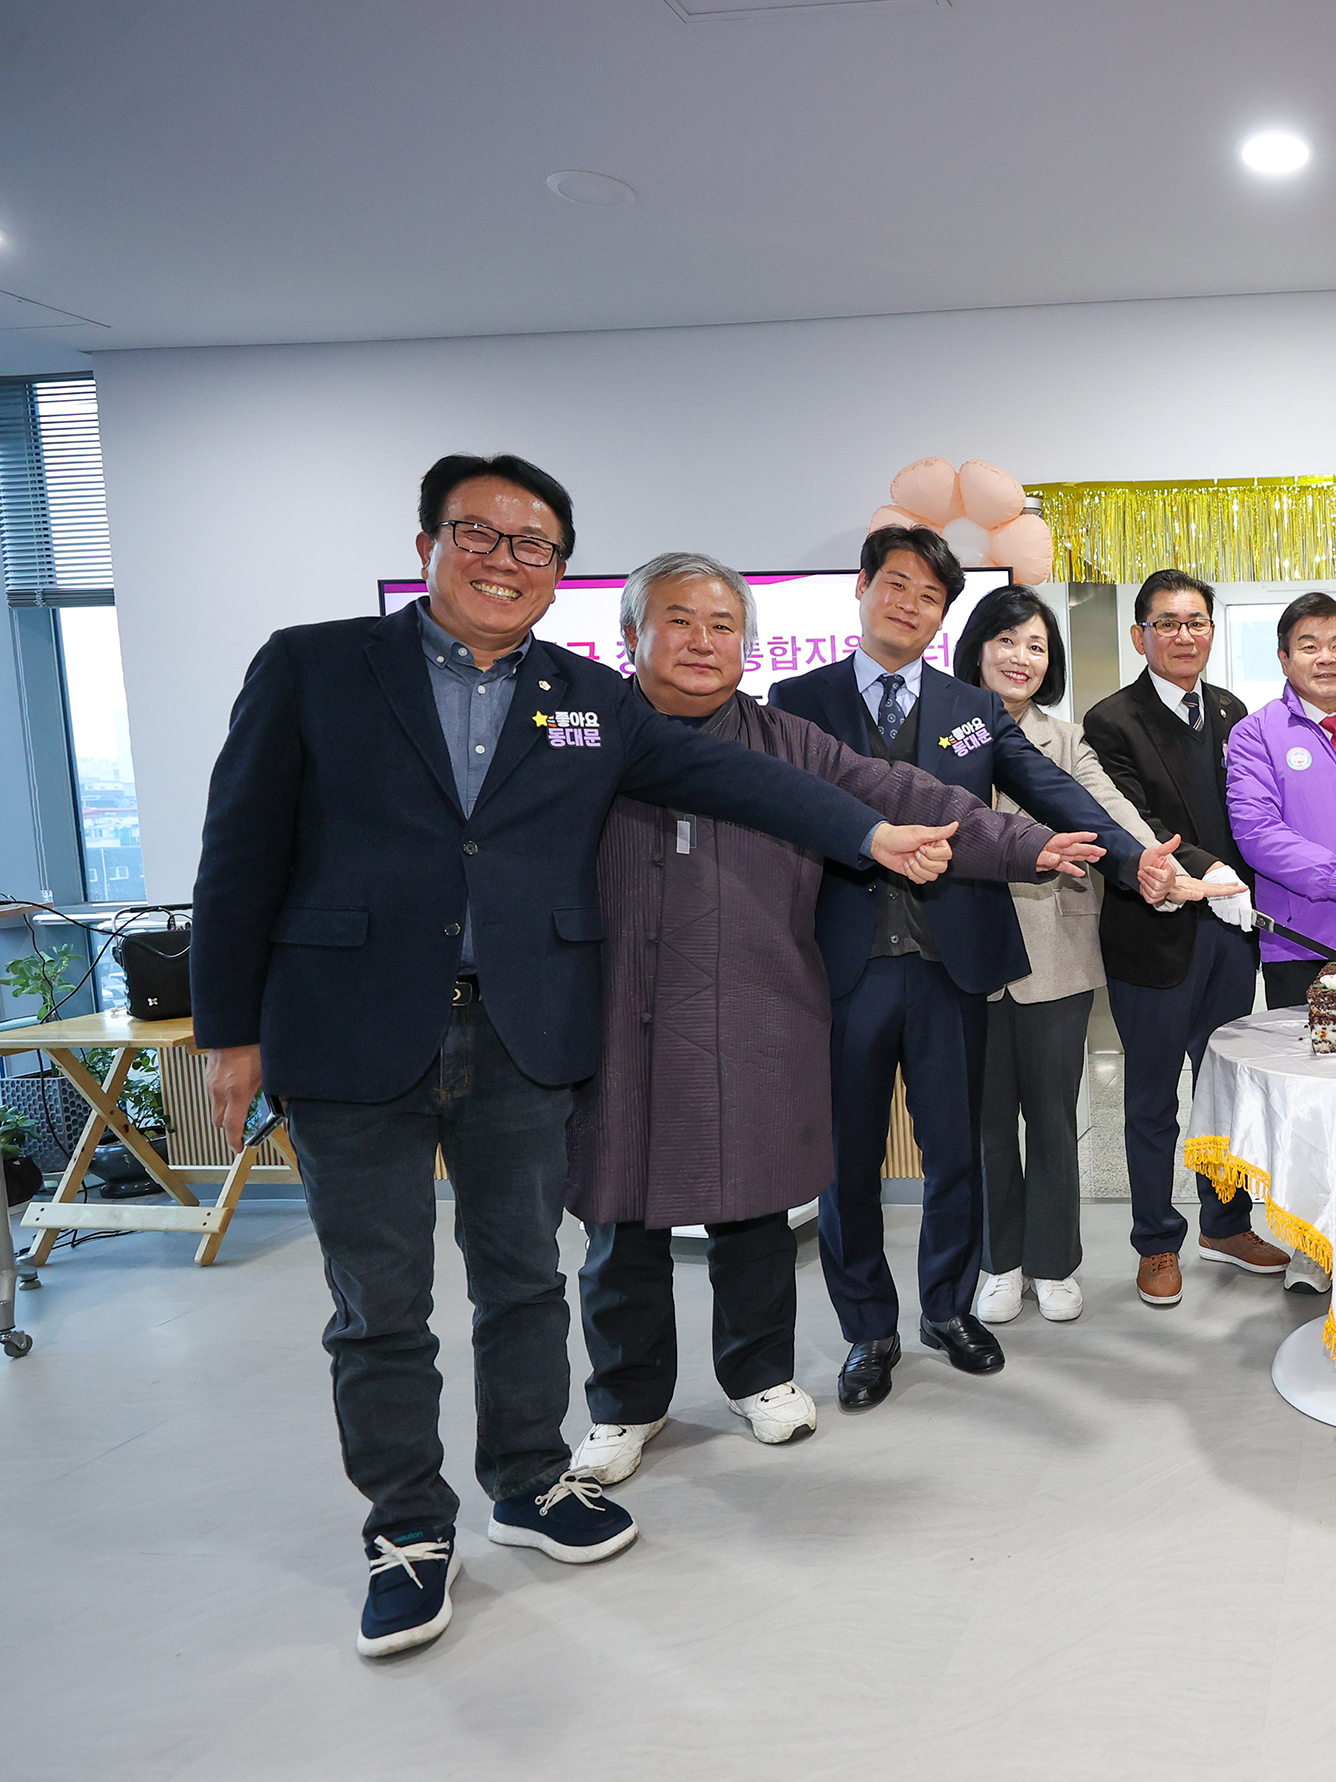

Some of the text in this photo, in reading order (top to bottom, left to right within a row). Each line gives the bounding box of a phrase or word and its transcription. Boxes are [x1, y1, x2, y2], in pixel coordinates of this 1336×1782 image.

[555, 711, 600, 728] 좋아요
[951, 717, 986, 741] 좋아요
[548, 727, 602, 747] 동대문
[952, 727, 993, 757] 동대문
